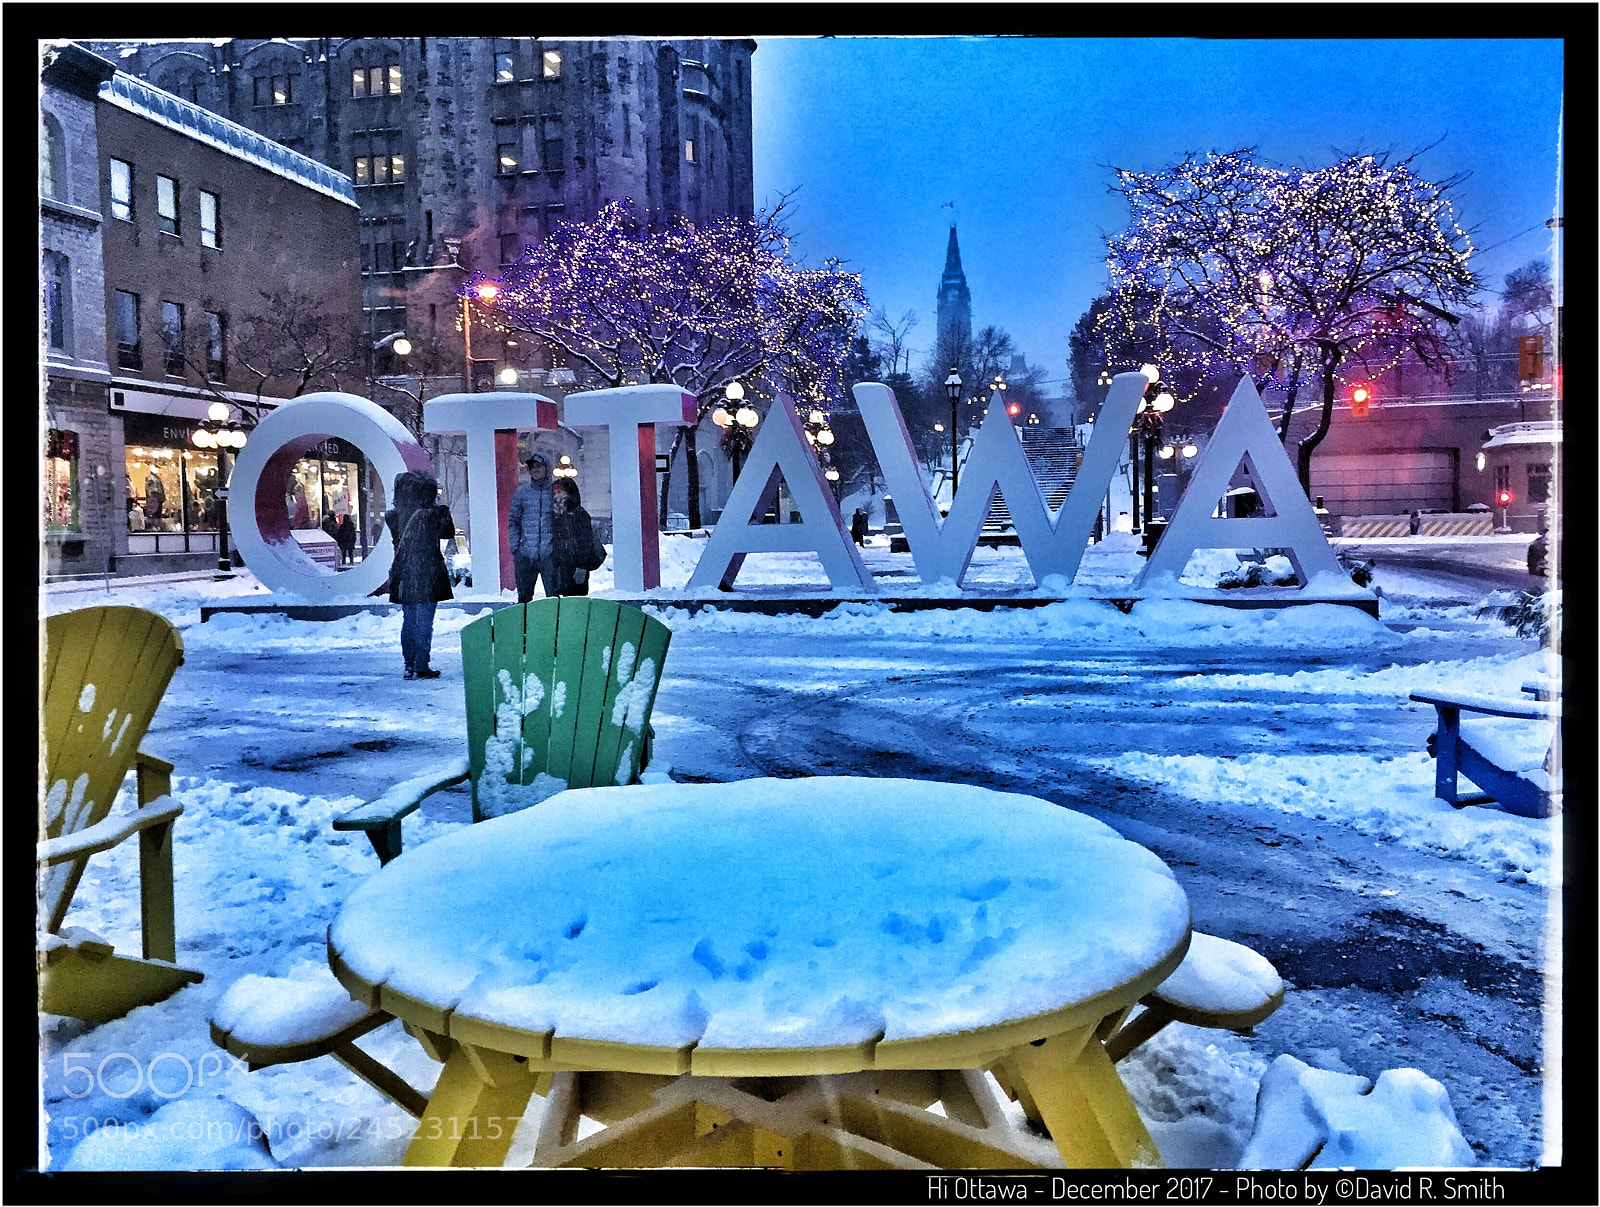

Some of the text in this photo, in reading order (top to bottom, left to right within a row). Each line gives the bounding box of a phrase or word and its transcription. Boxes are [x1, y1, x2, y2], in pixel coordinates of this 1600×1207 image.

[163, 427, 190, 439] ENVI
[309, 440, 339, 454] VIED
[229, 373, 1346, 597] OTTAWA
